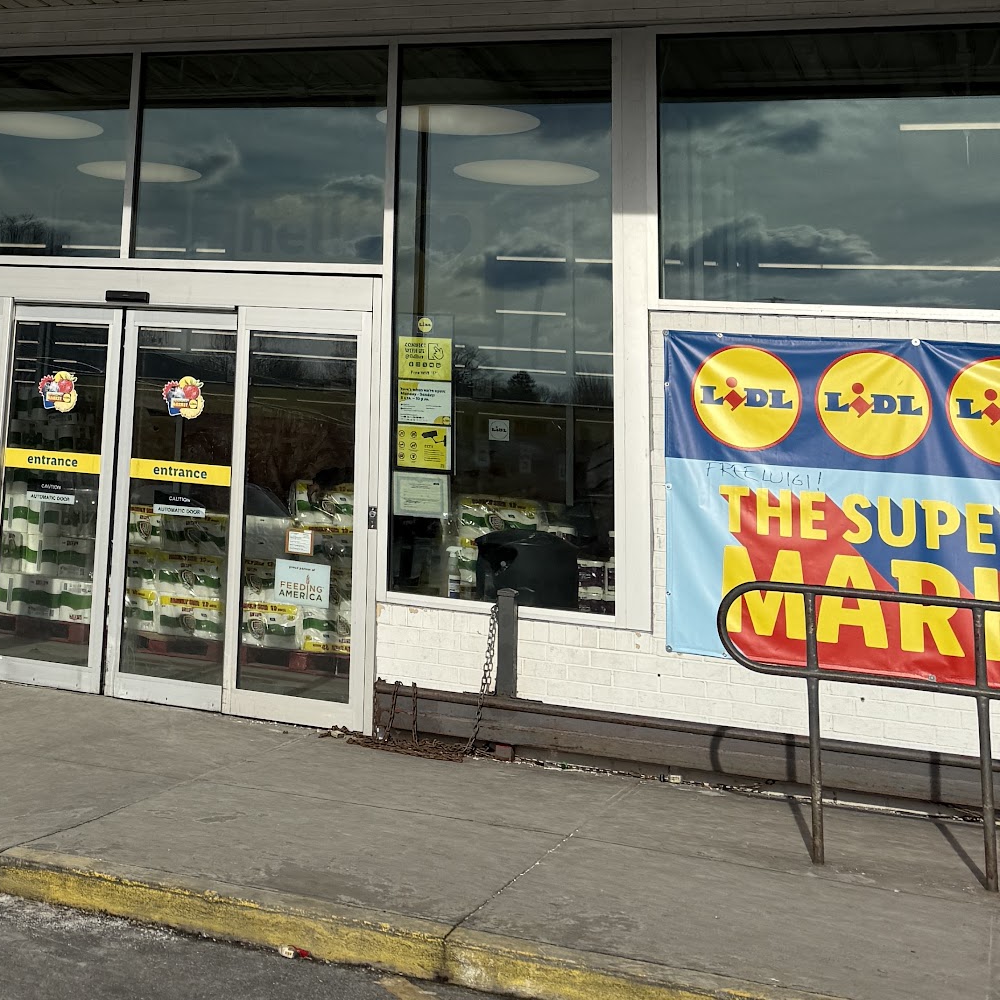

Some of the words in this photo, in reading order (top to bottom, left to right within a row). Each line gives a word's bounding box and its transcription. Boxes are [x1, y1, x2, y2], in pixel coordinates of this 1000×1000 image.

[27, 455, 78, 467] entrance
[153, 466, 208, 479] entrance
[719, 485, 828, 541] THE
[842, 493, 997, 555] SUPE
[280, 579, 323, 594] FEEDING
[278, 588, 323, 603] AMERICA
